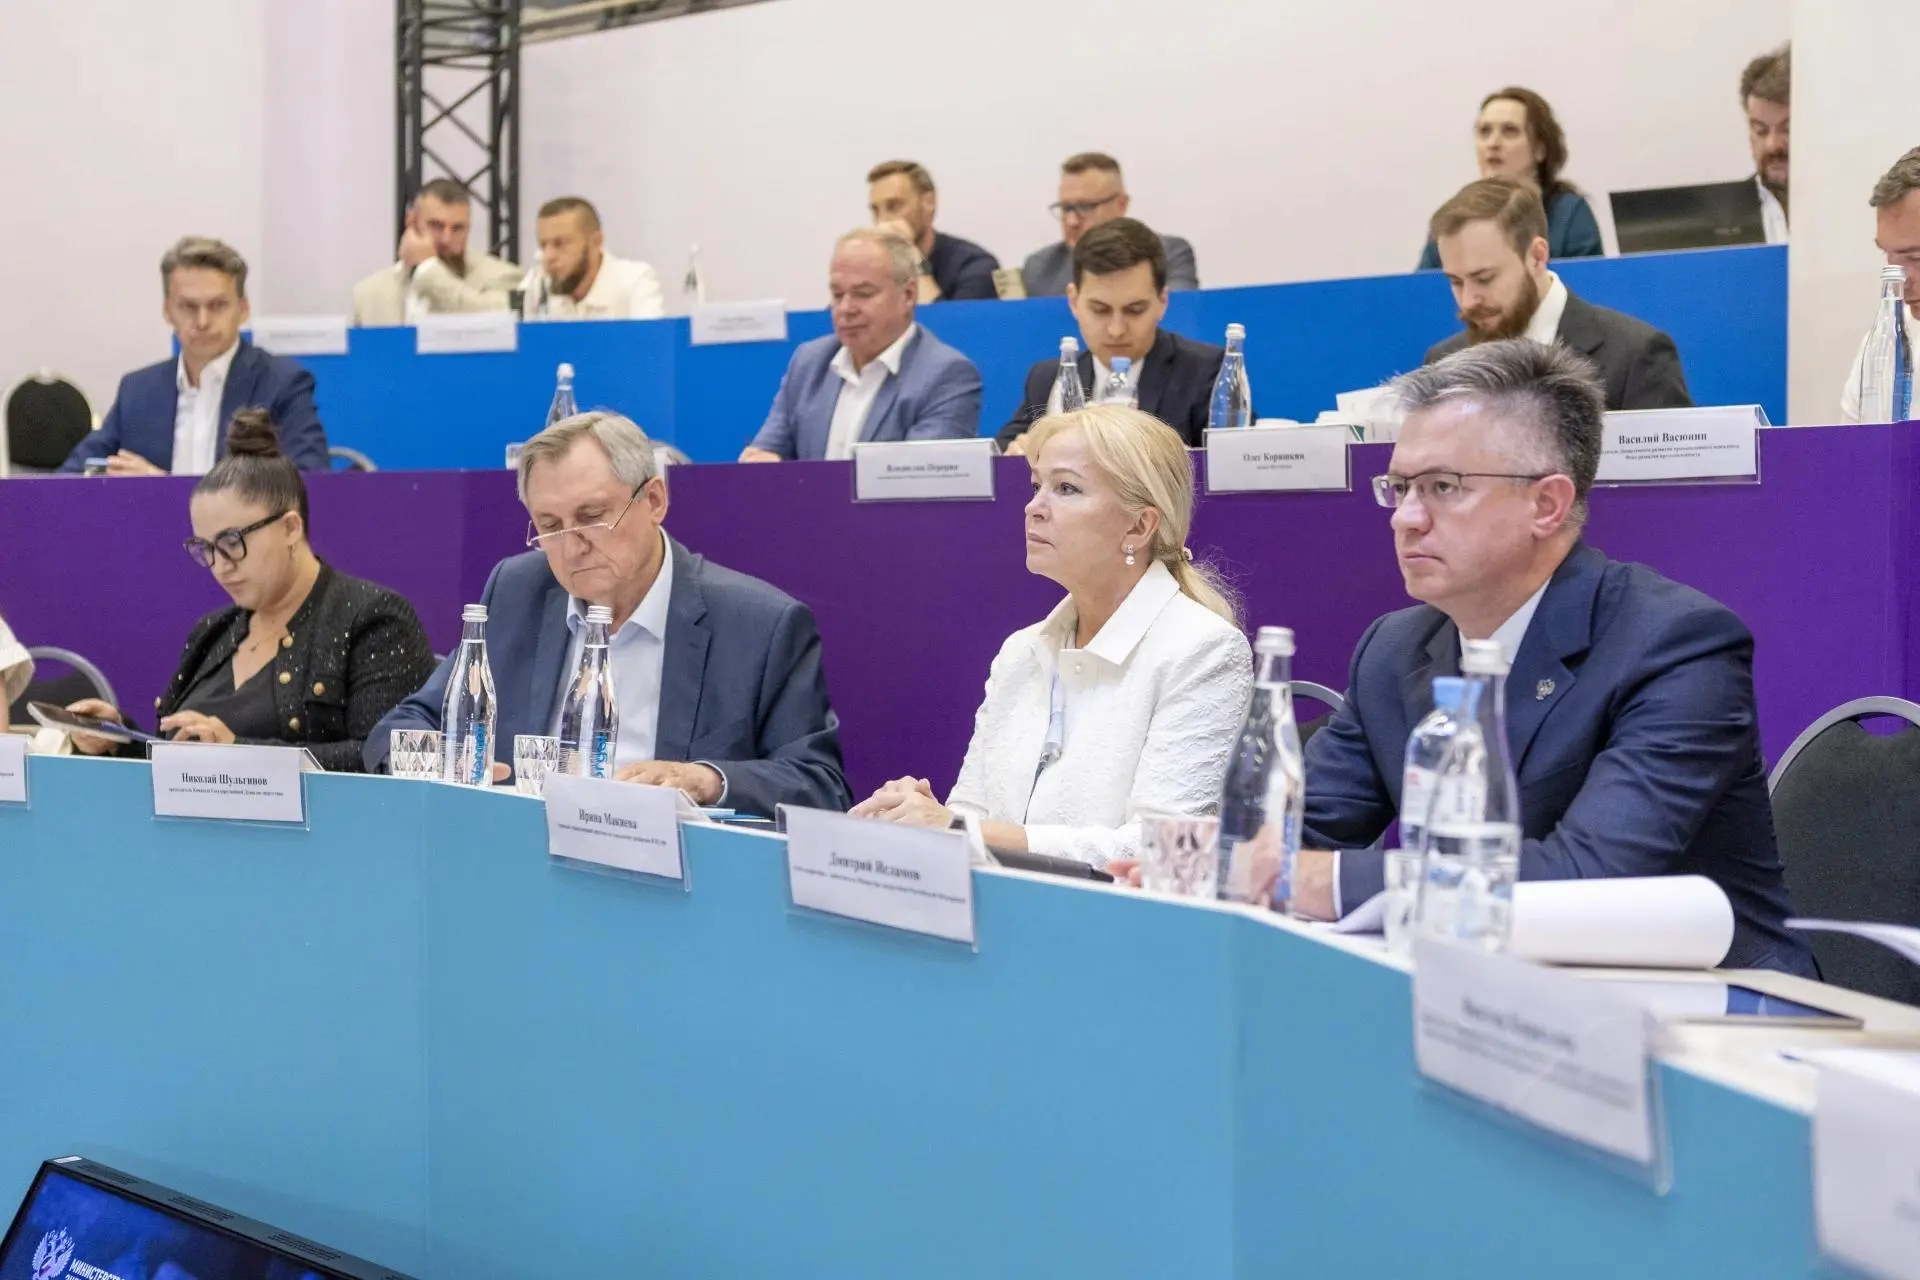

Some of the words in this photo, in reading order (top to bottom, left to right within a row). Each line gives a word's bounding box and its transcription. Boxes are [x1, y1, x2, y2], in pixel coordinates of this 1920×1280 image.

[1618, 434, 1660, 445] Василий
[1662, 431, 1708, 443] Васюнин
[181, 772, 217, 785] Николай
[219, 774, 269, 787] Шульгинов
[578, 807, 603, 825] Ирина
[828, 851, 873, 873] Дмитрий
